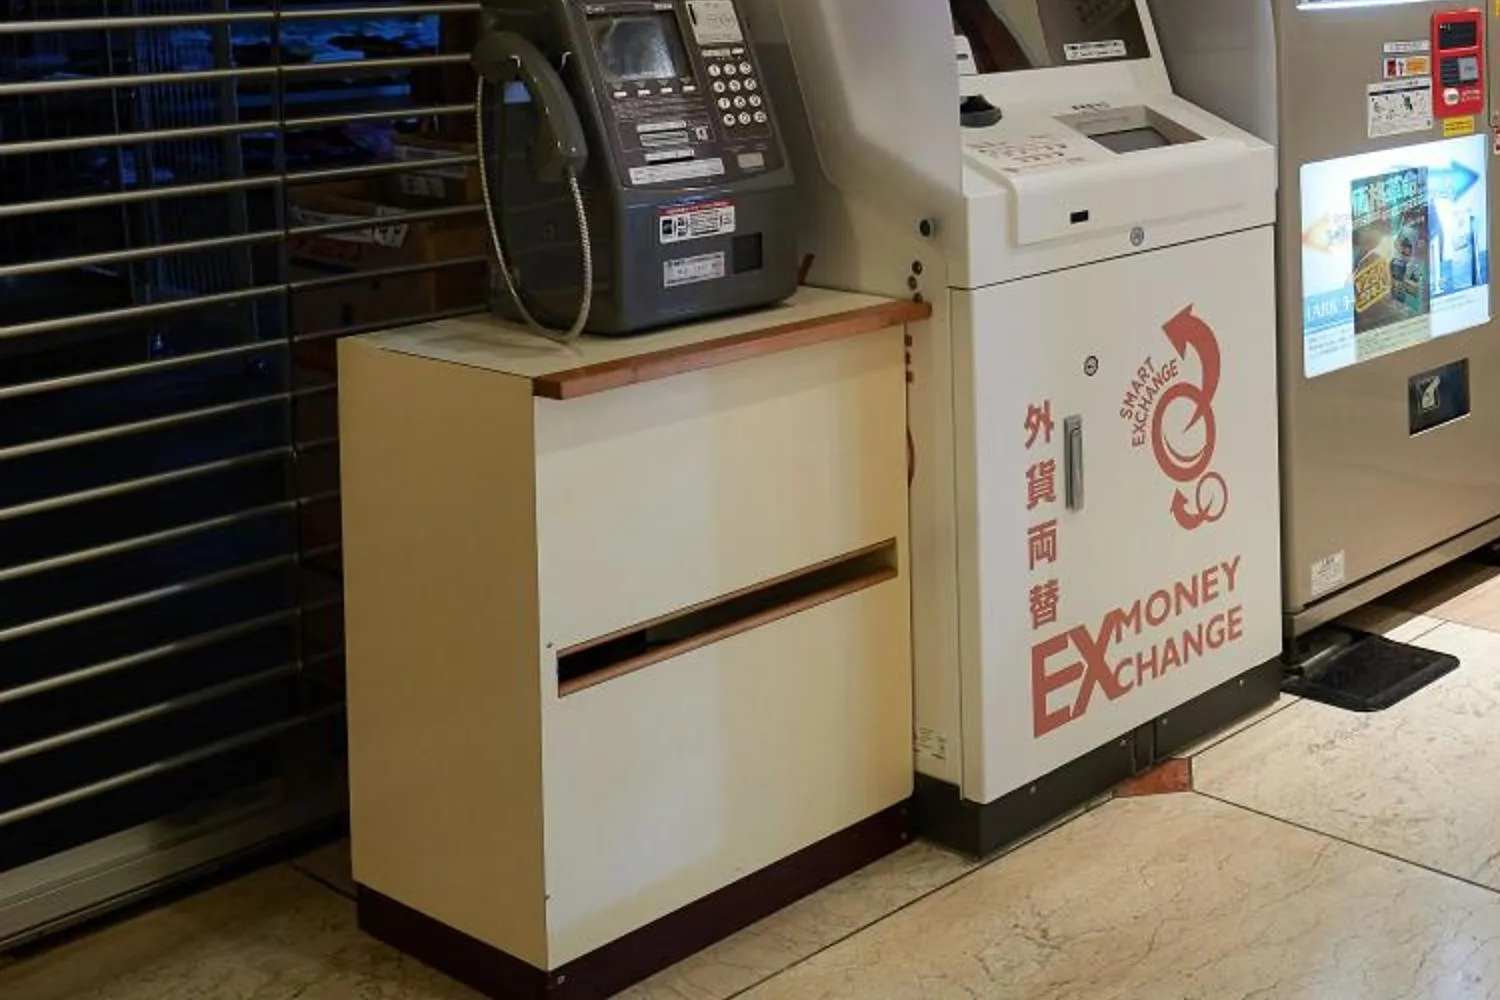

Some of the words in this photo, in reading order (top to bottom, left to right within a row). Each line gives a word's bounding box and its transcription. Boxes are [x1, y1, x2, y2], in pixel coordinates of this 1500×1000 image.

[1119, 356, 1156, 420] SMART
[1131, 359, 1180, 448] EXCHANGE
[1023, 400, 1060, 630] 外貨両替
[1114, 556, 1241, 644] MONEY
